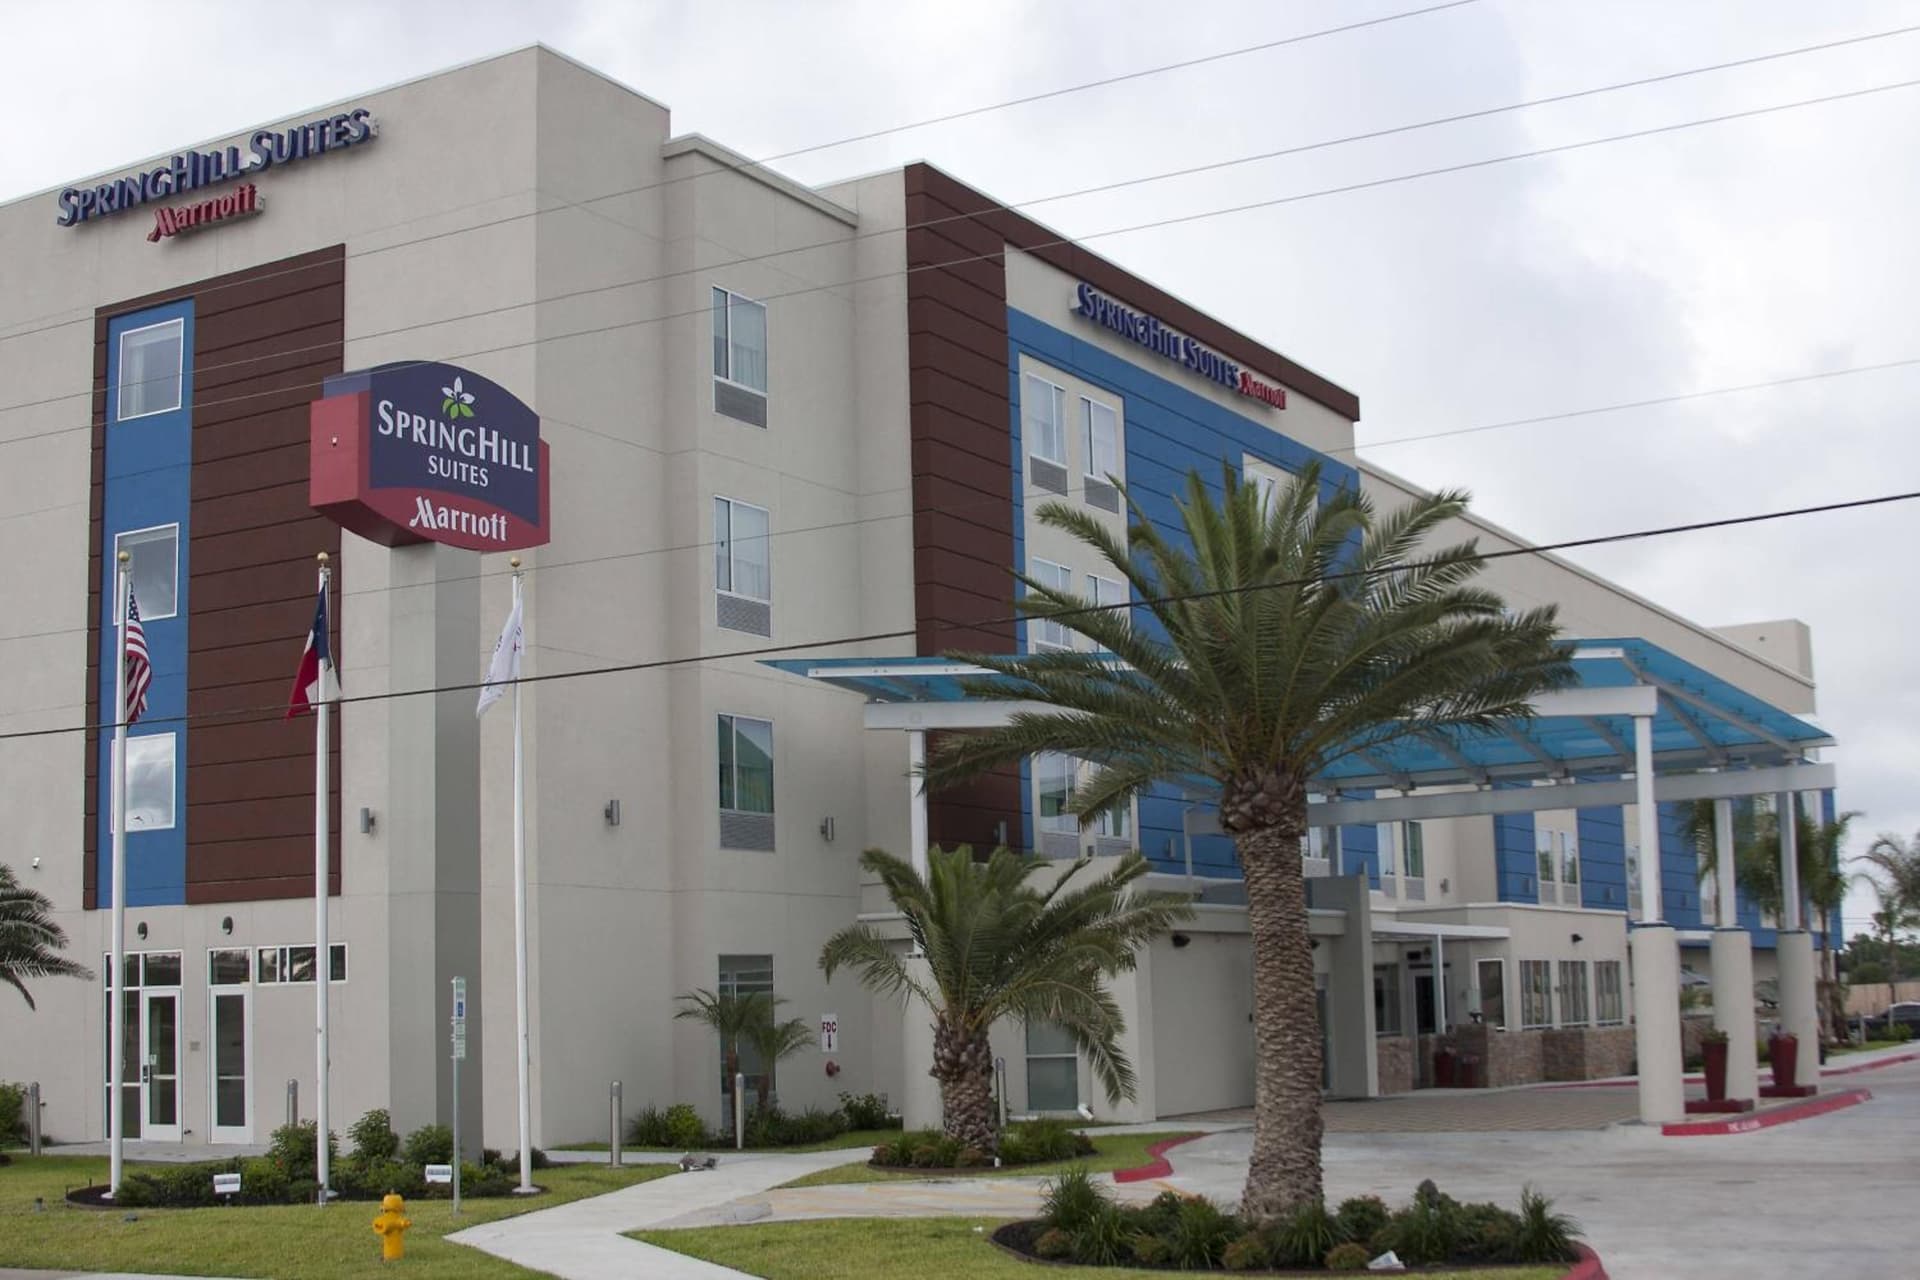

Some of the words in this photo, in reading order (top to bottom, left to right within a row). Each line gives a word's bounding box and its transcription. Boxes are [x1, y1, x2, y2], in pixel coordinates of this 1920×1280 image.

[147, 183, 257, 242] Marriott
[1239, 371, 1287, 410] Marriott
[428, 455, 489, 487] SUITES
[409, 496, 508, 541] Marriott
[822, 1021, 837, 1033] FDC
